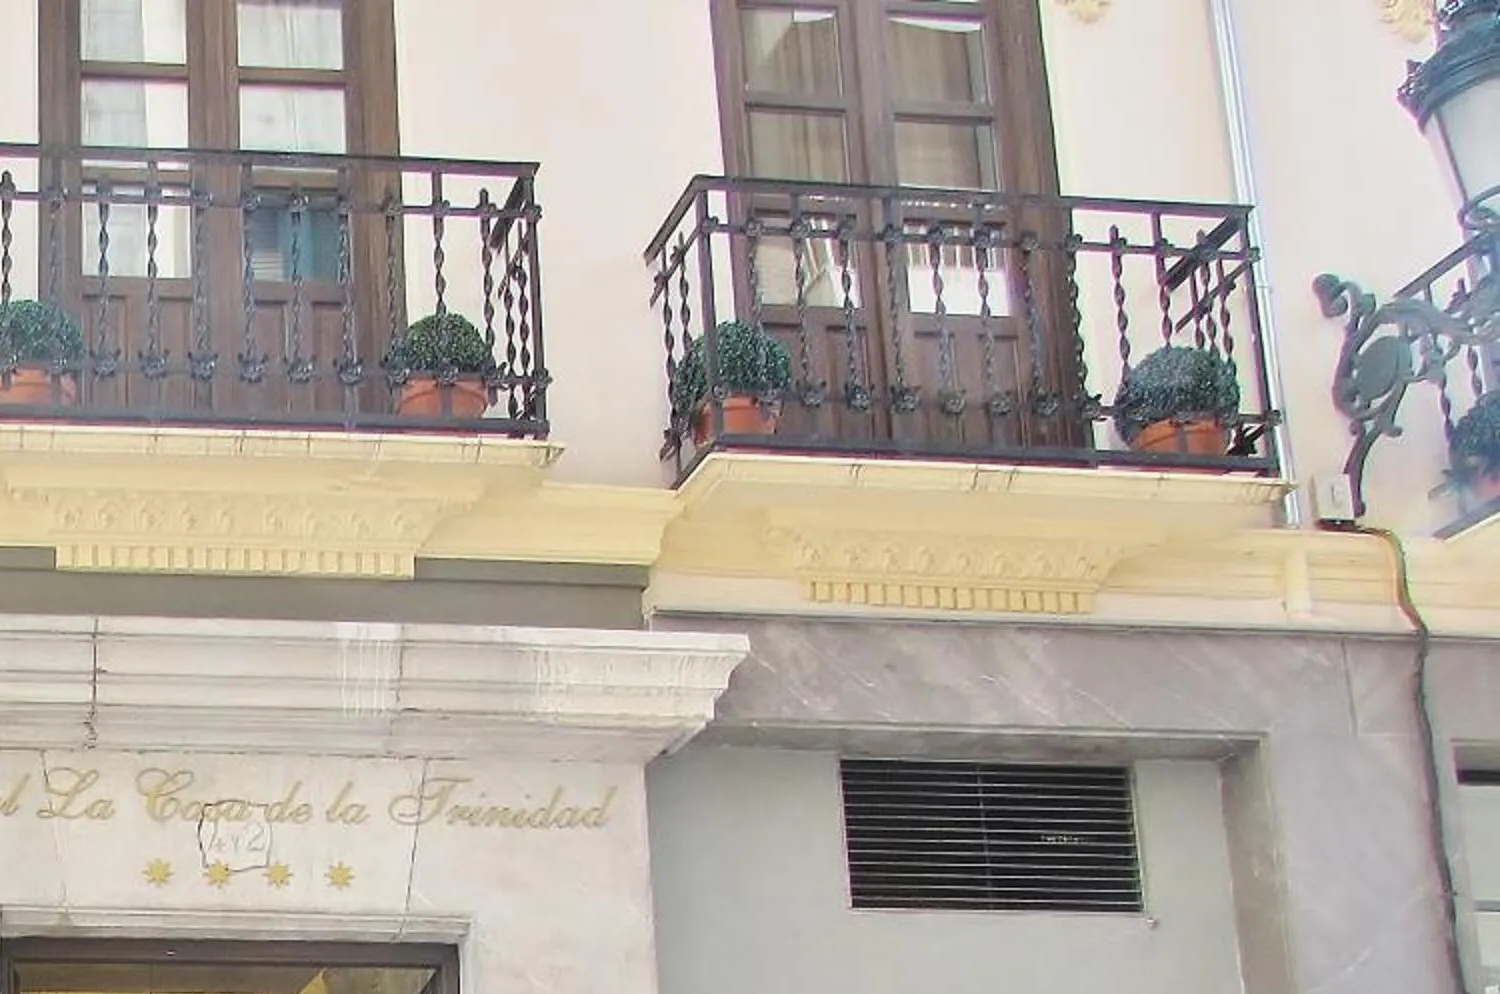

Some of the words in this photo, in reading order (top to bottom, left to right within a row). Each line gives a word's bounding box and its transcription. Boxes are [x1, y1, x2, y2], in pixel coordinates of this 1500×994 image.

[38, 766, 116, 821] La
[135, 766, 252, 823] Casa
[264, 780, 312, 824] de
[325, 779, 369, 826] la
[387, 775, 617, 830] Trinidad
